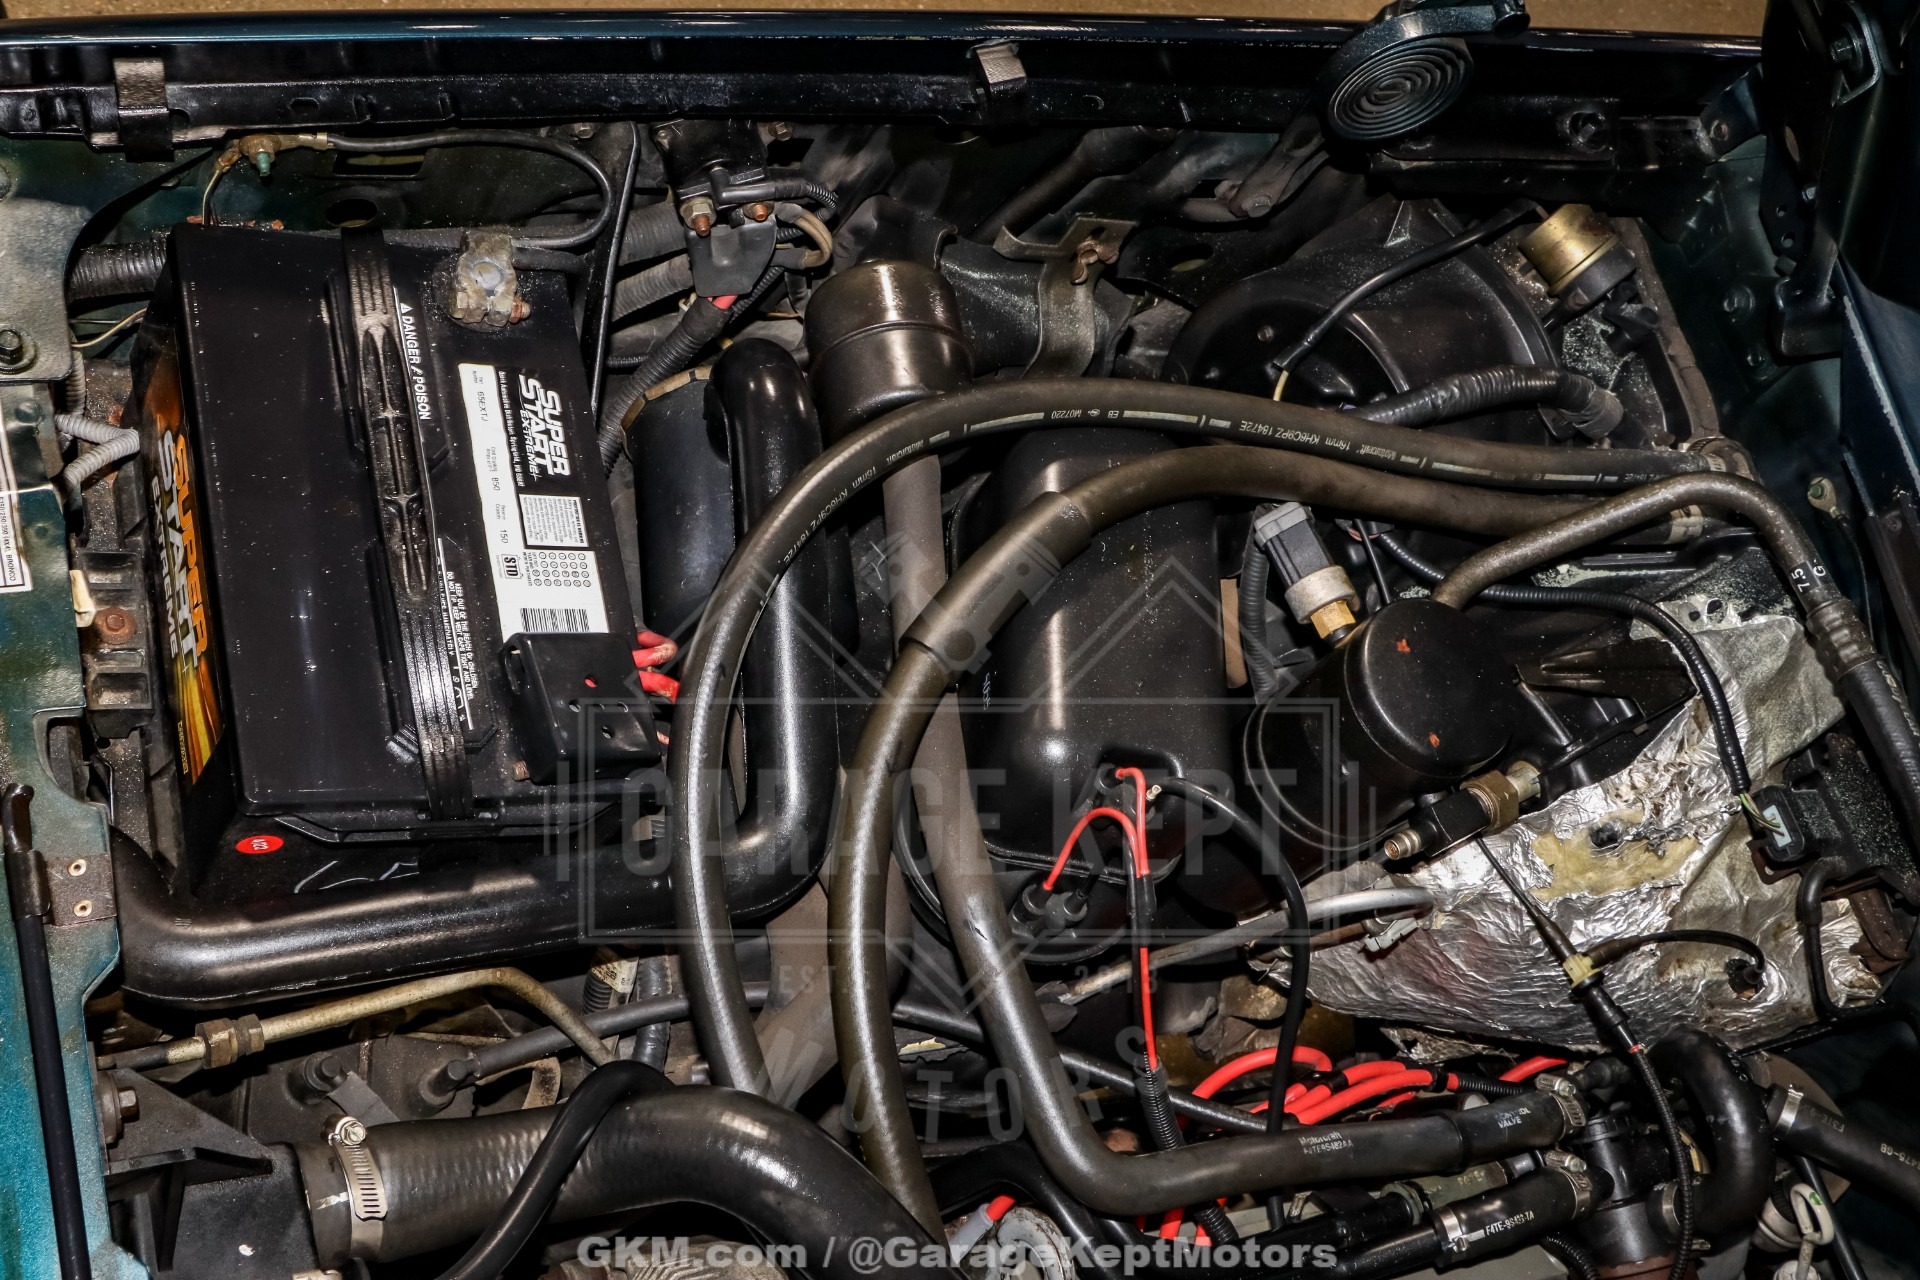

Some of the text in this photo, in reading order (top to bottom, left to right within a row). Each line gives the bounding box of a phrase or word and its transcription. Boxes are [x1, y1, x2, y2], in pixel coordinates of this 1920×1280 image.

[402, 314, 421, 364] DANGER
[412, 374, 431, 421] POISON
[498, 383, 510, 408] Automotive
[518, 374, 555, 475] START
[1051, 409, 1118, 418] EB M07220
[520, 410, 538, 475] EXTREME
[539, 389, 571, 476] SUPER
[1238, 419, 1396, 460] Motorcraft 16mm KH6C9PZ 18472E
[491, 477, 500, 491] 850
[852, 467, 876, 488] 16mm
[158, 430, 198, 668] START
[172, 434, 208, 657] SUPER
[499, 528, 508, 544] 150
[6, 554, 16, 582] BRONCO
[152, 476, 176, 659] EXTREME
[503, 555, 518, 578] STD
[1792, 567, 1810, 593] 7.5
[447, 580, 456, 592] NOT
[452, 605, 460, 620] KEEP
[457, 636, 465, 651] CAPS
[462, 632, 471, 651] REACH
[1497, 1116, 1522, 1128] VALVE
[1298, 1130, 1342, 1146] Motorcraft
